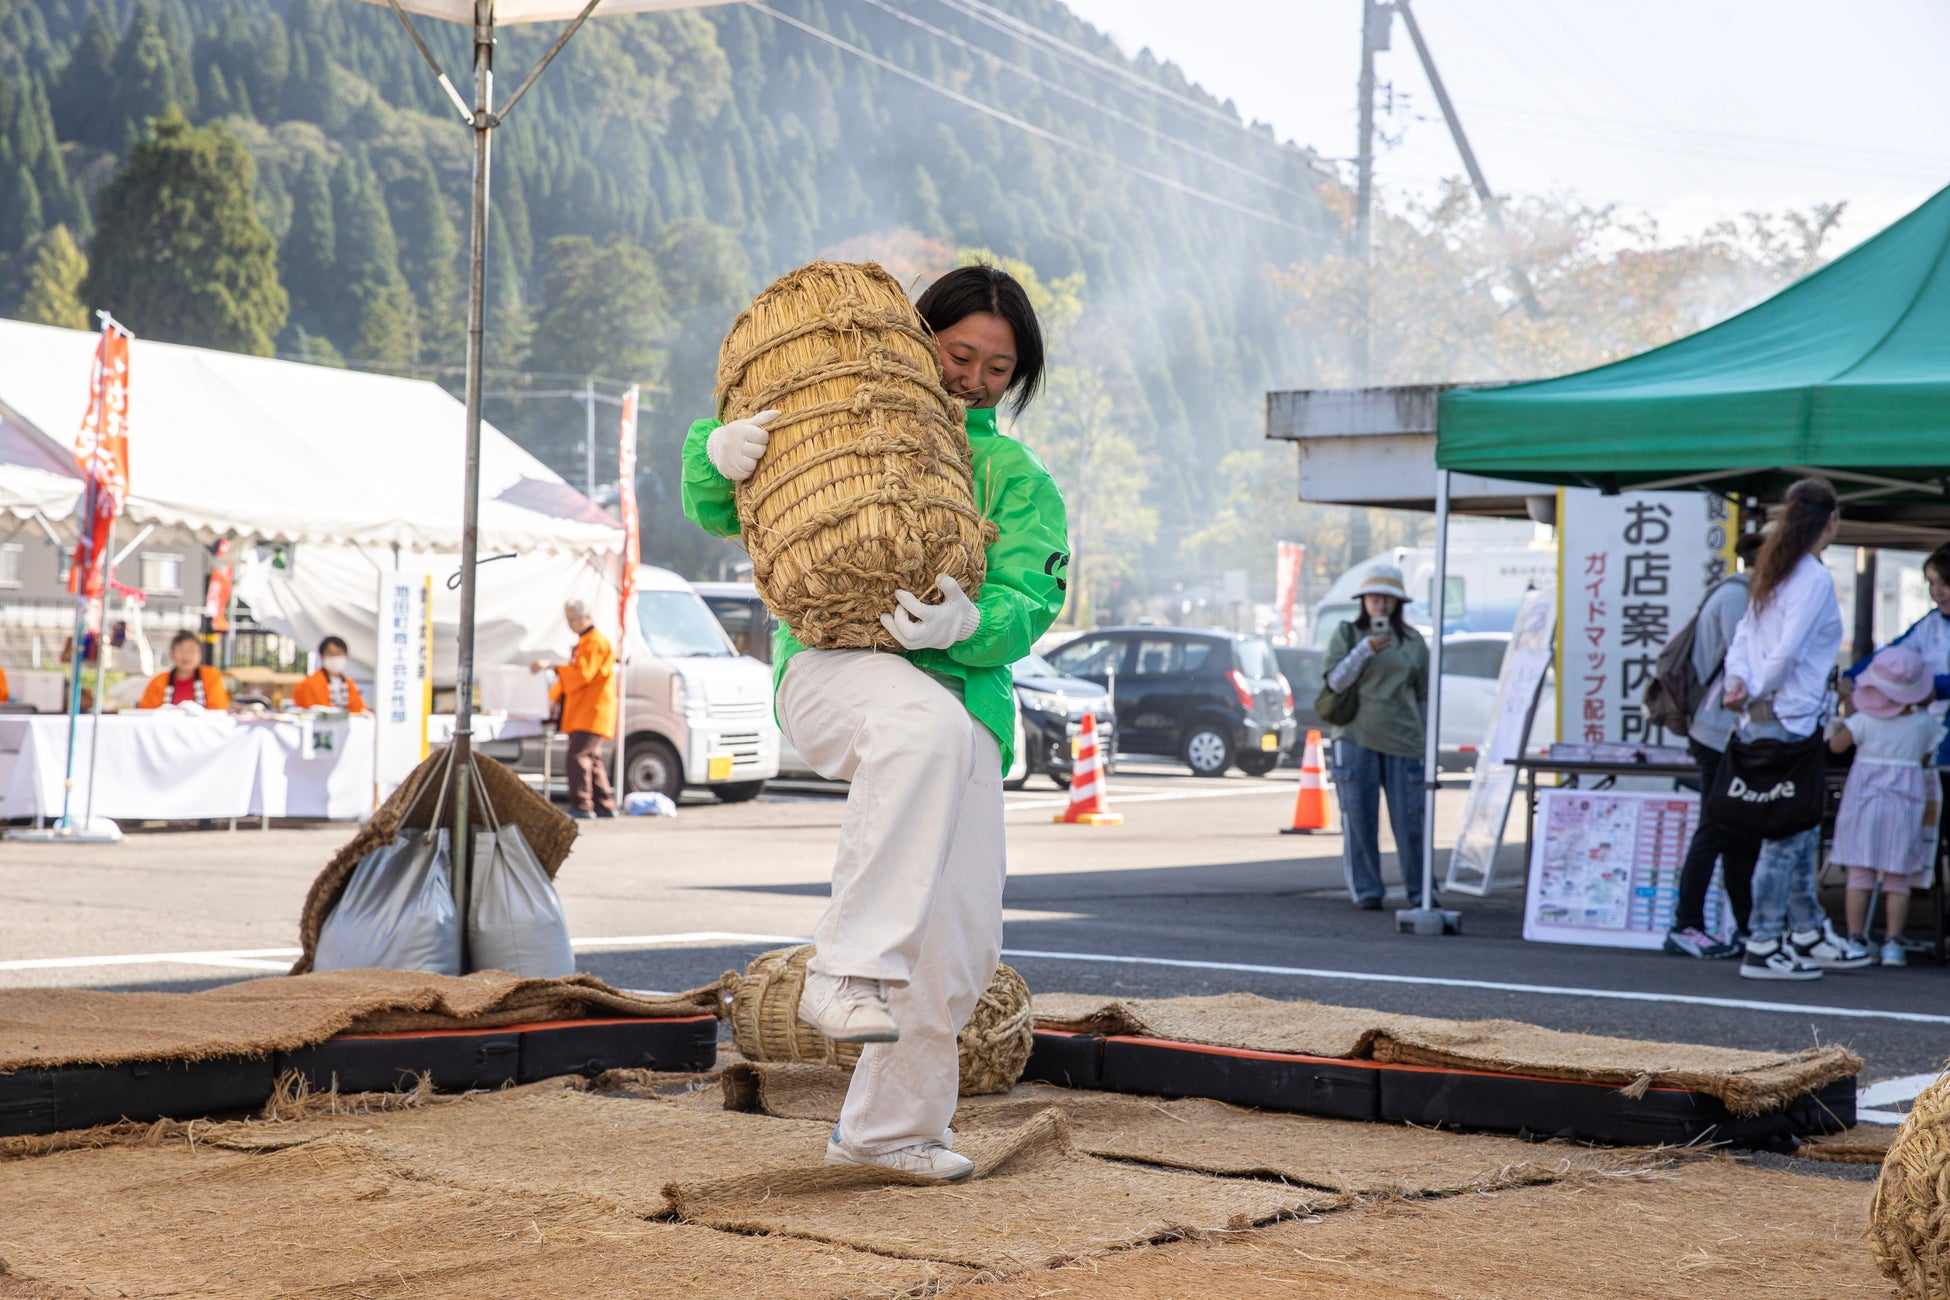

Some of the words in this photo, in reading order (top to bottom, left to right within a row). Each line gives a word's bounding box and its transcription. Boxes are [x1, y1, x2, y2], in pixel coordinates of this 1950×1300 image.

[1583, 553, 1608, 743] ガイドマップ配布
